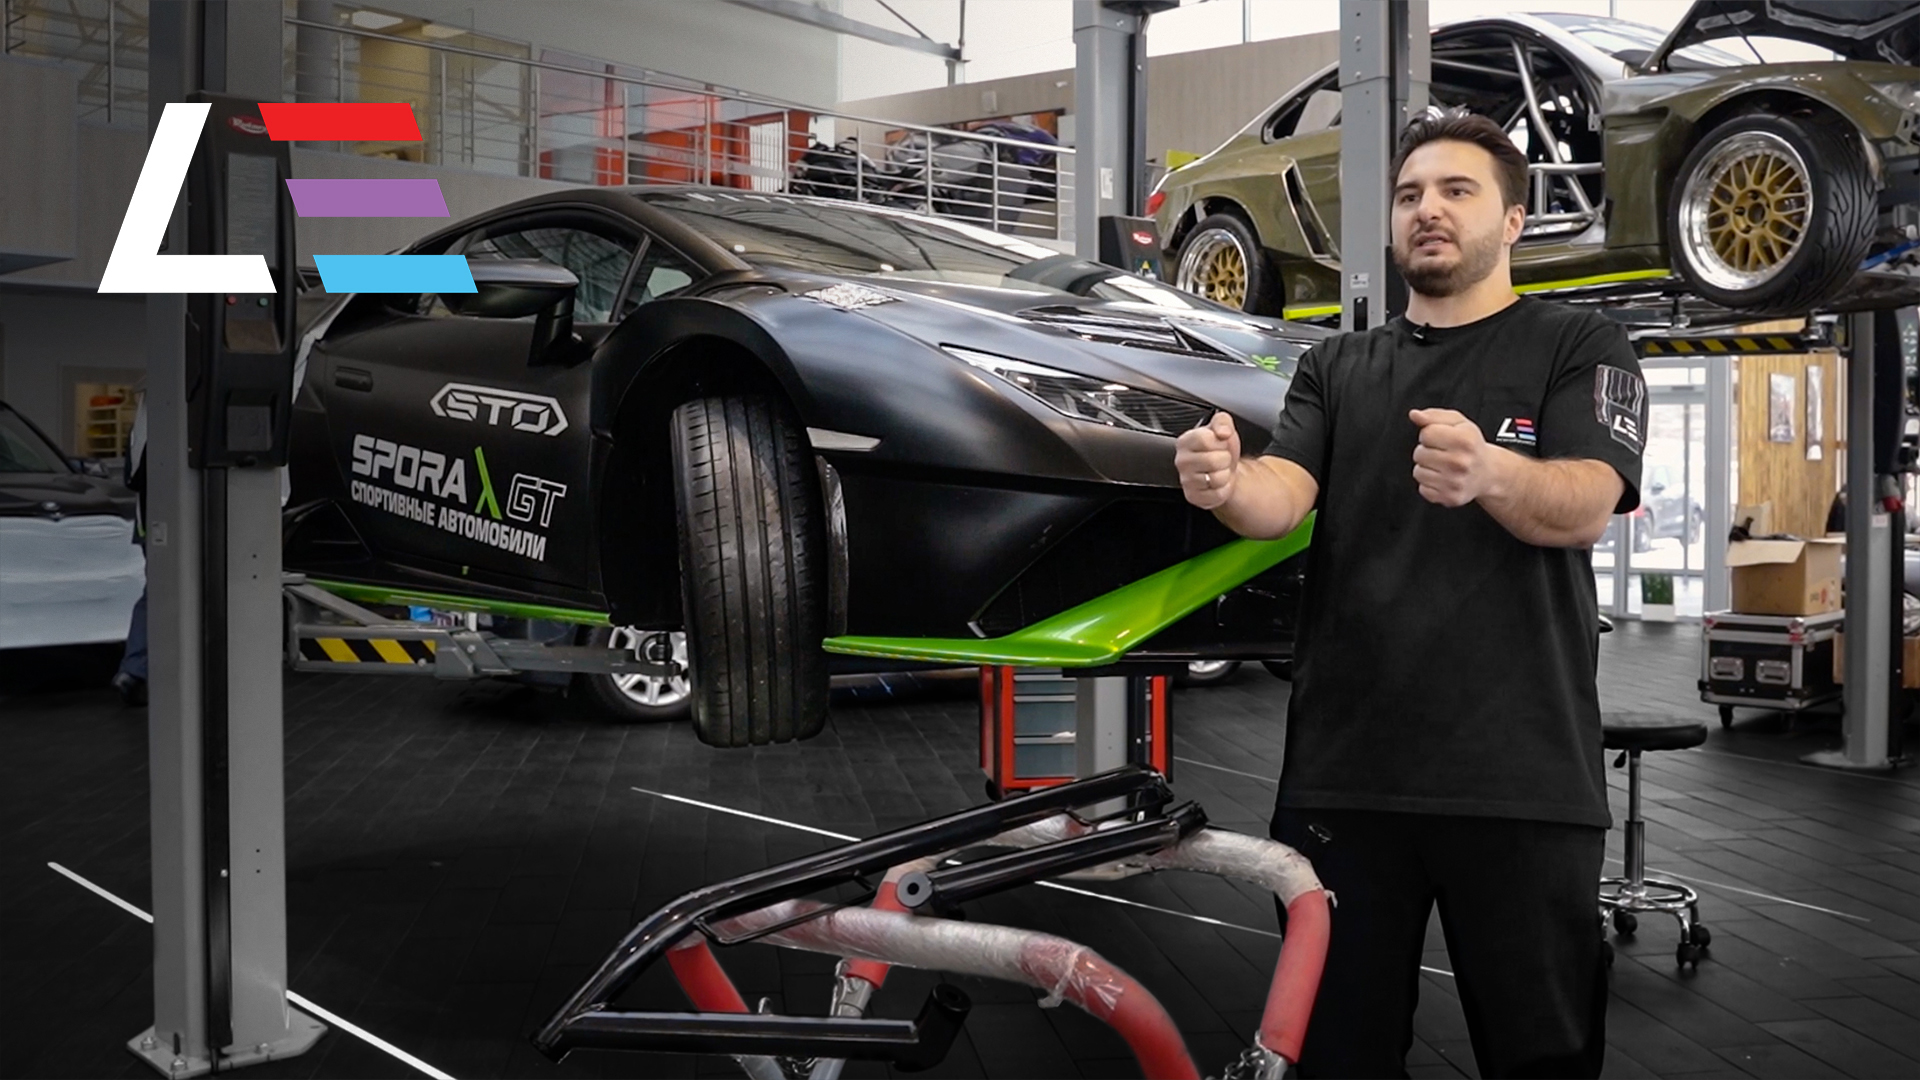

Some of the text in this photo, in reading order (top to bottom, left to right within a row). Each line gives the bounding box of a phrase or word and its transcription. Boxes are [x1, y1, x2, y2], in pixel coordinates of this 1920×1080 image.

[446, 391, 551, 433] STO
[351, 480, 547, 562] СПОРТИВНЫЕ АВТОМОБИЛИ
[352, 434, 467, 504] SPORA
[506, 473, 567, 528] GT
